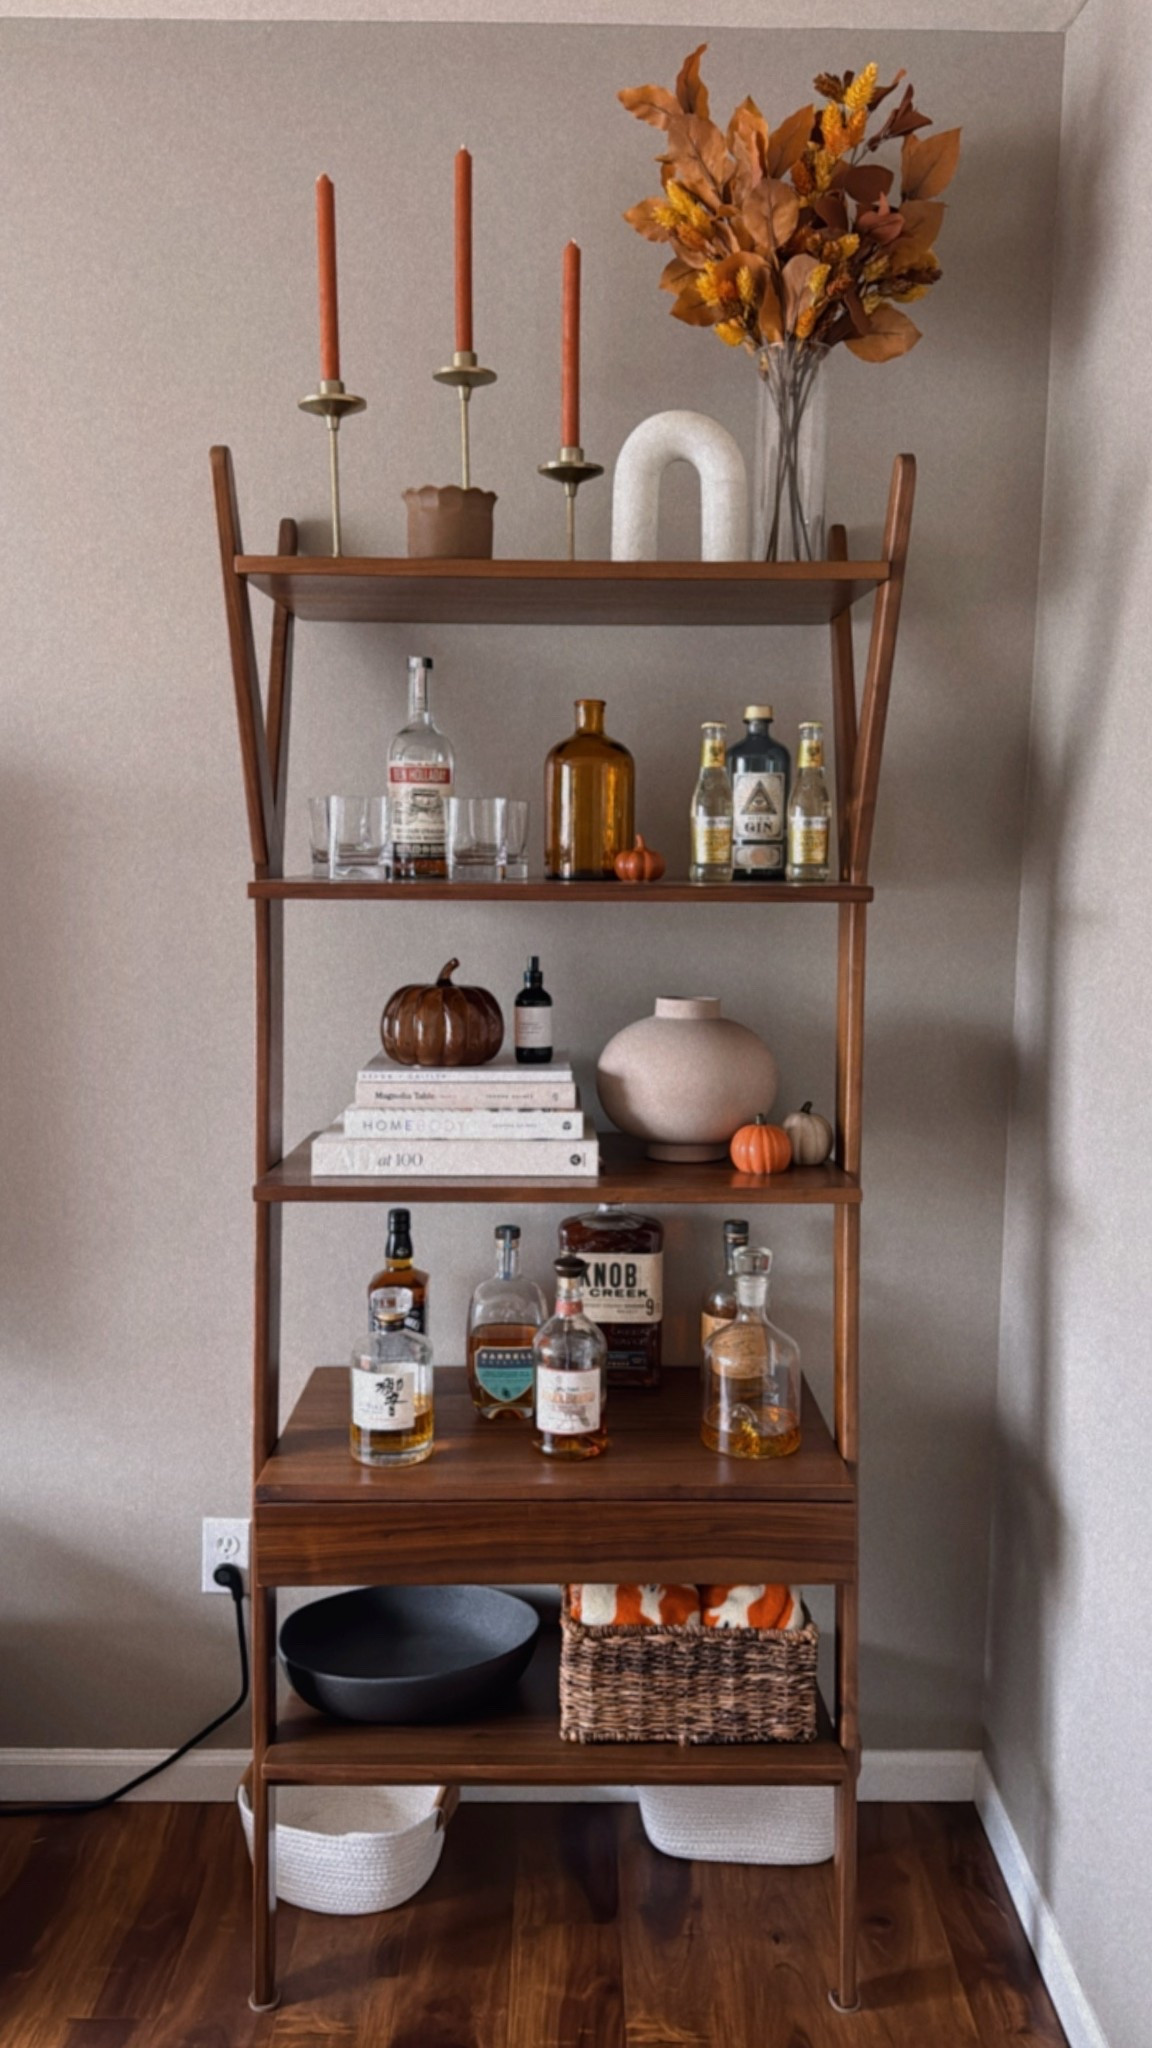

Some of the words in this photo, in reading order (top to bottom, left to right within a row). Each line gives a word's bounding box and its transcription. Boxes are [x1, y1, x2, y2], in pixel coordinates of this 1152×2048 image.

[744, 821, 773, 833] GIN
[375, 1091, 412, 1101] Magnolia
[414, 1091, 436, 1100] Table
[362, 1119, 464, 1132] HOMEBODY
[377, 1153, 392, 1167] at
[396, 1153, 423, 1167] 100
[580, 1262, 637, 1288] KNOB
[589, 1288, 649, 1298] CREEK
[645, 1298, 655, 1317] 9
